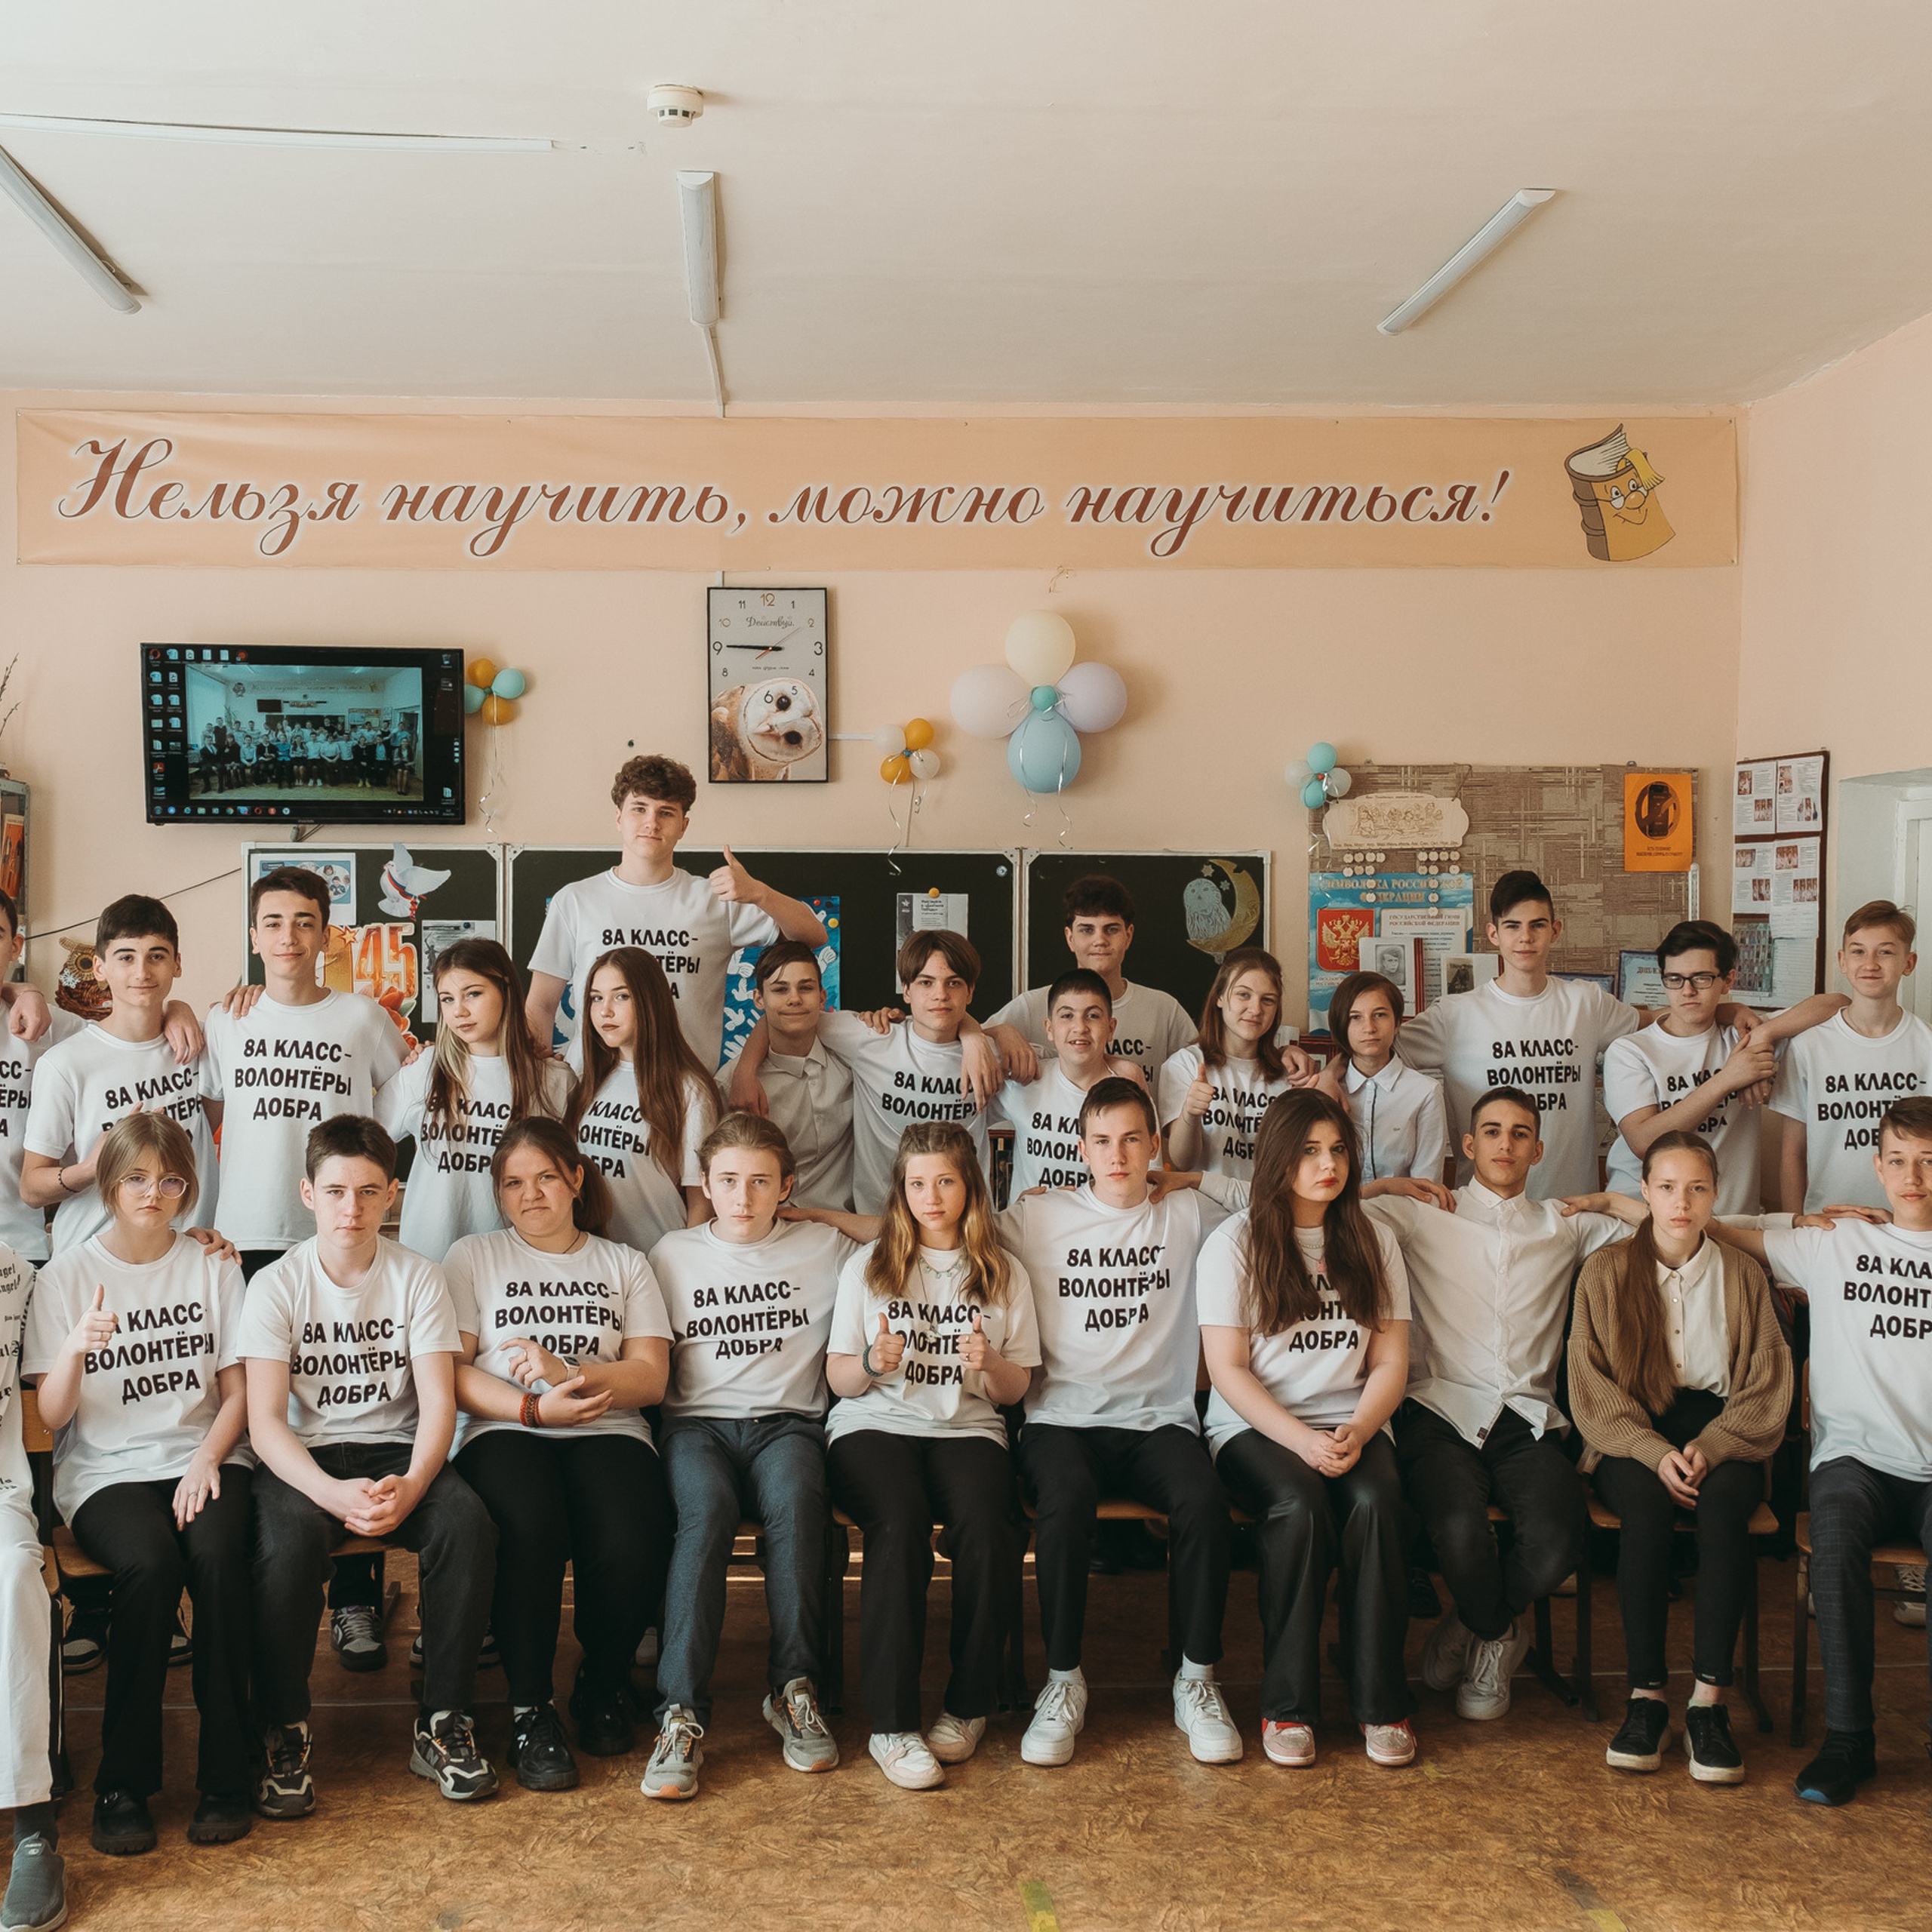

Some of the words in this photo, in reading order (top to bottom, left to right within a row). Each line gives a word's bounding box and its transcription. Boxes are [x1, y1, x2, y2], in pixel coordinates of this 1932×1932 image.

[58, 438, 359, 556] Нельзя
[381, 482, 746, 557] научить,
[768, 485, 1045, 524] можно
[1066, 470, 1510, 557] научиться!
[739, 601, 746, 609] 11
[760, 593, 775, 607] 12
[719, 618, 731, 628] 10
[808, 618, 815, 628] 2
[712, 641, 723, 656] 9
[814, 641, 823, 656] 3
[721, 668, 729, 678] 8
[808, 669, 815, 678] 4
[764, 691, 774, 704] 6
[792, 686, 798, 696] 5
[1318, 878, 1389, 890] СИМВОЛКА
[1391, 877, 1464, 890] РОССИКОЙ
[1359, 892, 1425, 904] ФДЕРАЦИИ
[602, 929, 626, 946] 8А
[631, 929, 698, 946] КЛАСС-
[244, 1038, 267, 1057] 8А
[273, 1039, 352, 1063] КЛАСС-
[1106, 1038, 1152, 1056] АСС-
[1492, 1041, 1516, 1059] 8А
[1520, 1038, 1579, 1057] КЛАСС-
[235, 1066, 351, 1096] ВОЛОНТЁРЫ
[894, 1070, 915, 1091] 8А
[1487, 1060, 1581, 1086] ВОЛОНТЁРЫ
[1667, 1075, 1689, 1092] 8А
[1825, 1075, 1849, 1094] 8А
[1854, 1072, 1927, 1091] КЛАСС-
[105, 1090, 134, 1109] 8А
[135, 1067, 199, 1101] КЛАСС-
[253, 1097, 322, 1121] ДОБРА
[457, 1098, 511, 1120] КЛАС
[588, 1100, 642, 1124] КЛАСС
[1817, 1095, 1902, 1121] ВОЛОНТ
[1032, 1112, 1052, 1131] 8А
[420, 1121, 504, 1146] ВОЛОНТЁ
[577, 1124, 651, 1156] ОНТЁРЫ
[1027, 1137, 1084, 1162] ВОЛОН
[438, 1151, 491, 1174] ДОБР
[1066, 1248, 1093, 1267] 8А
[1856, 1254, 1883, 1274] 8А
[506, 1281, 534, 1298] 8А
[540, 1281, 619, 1299] КЛАСС-
[693, 1287, 719, 1308] 8А
[724, 1281, 801, 1305] КЛАСС-
[1058, 1269, 1171, 1298] ВОЛОНТЁРЫ
[1844, 1281, 1932, 1309] ВОЛОНТ
[127, 1302, 204, 1333] КЛАСС
[495, 1300, 623, 1334] ВОЛОНТЁРЫ
[686, 1306, 810, 1339] ВОЛОНТЁРЫ
[888, 1300, 914, 1320] 8А
[918, 1303, 992, 1324] КЛАСС-
[1084, 1303, 1149, 1332] ДОБРА
[302, 1322, 327, 1344] 8А
[334, 1318, 405, 1343] КЛАСС-
[1288, 1330, 1358, 1353] ДОБРА
[84, 1331, 214, 1374] ВОЛОНТЁРЫ
[715, 1337, 783, 1360] ДОБРА
[904, 1360, 964, 1386] ДОБРА
[122, 1368, 202, 1405] ДОБРА
[317, 1381, 392, 1409] ДОБРА
